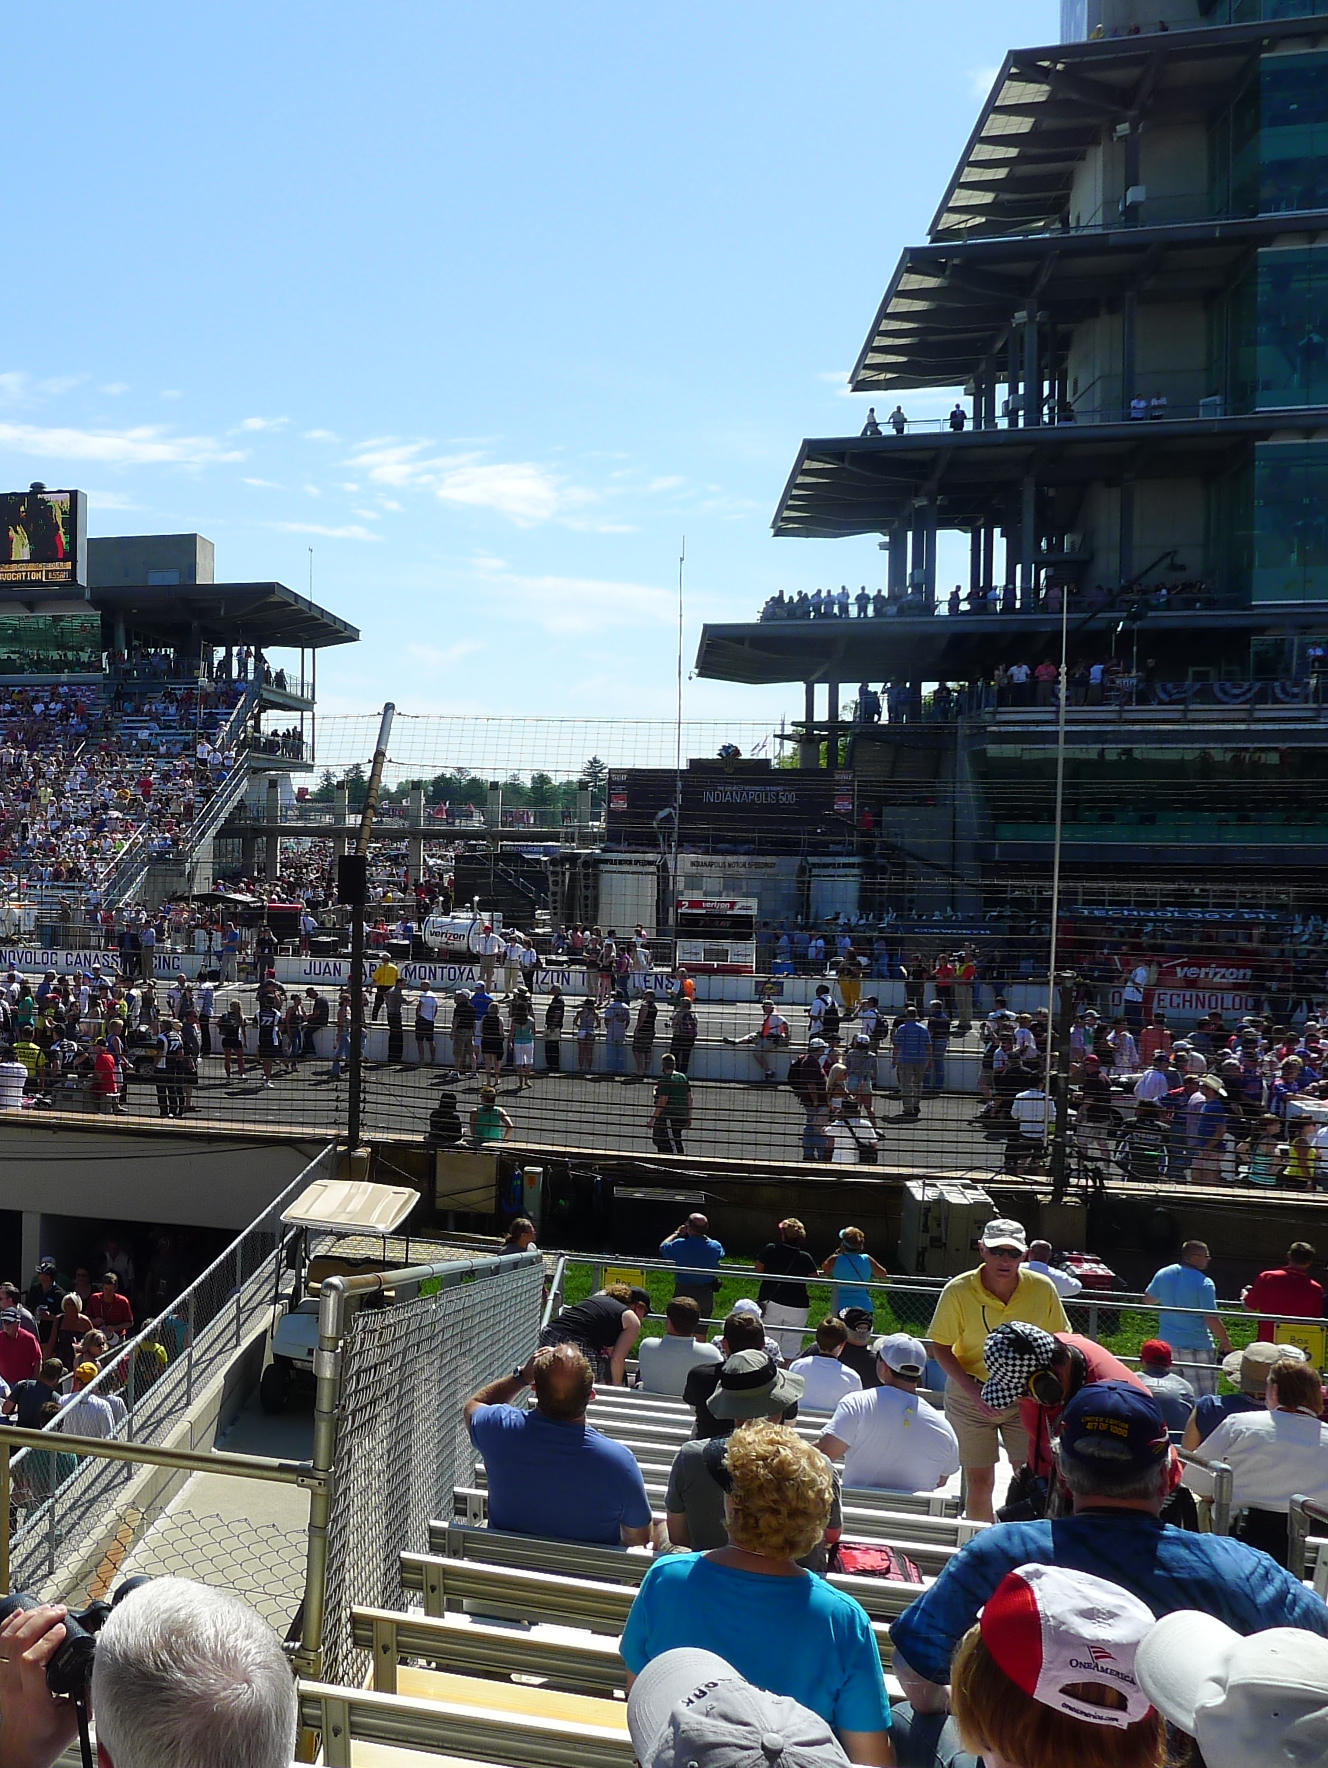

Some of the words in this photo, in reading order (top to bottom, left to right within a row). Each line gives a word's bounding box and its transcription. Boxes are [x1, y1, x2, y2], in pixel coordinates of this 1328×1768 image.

[703, 791, 777, 804] INDIANAPOLIS
[778, 791, 796, 804] 500
[681, 901, 689, 911] 2
[429, 929, 466, 942] verizon
[0, 949, 58, 965] NOVOLOG
[303, 960, 343, 978] JUAN
[404, 965, 476, 983] MONTOYA
[1176, 964, 1252, 983] verizon
[1289, 1335, 1309, 1345] Box
[1110, 1424, 1129, 1438] 1000
